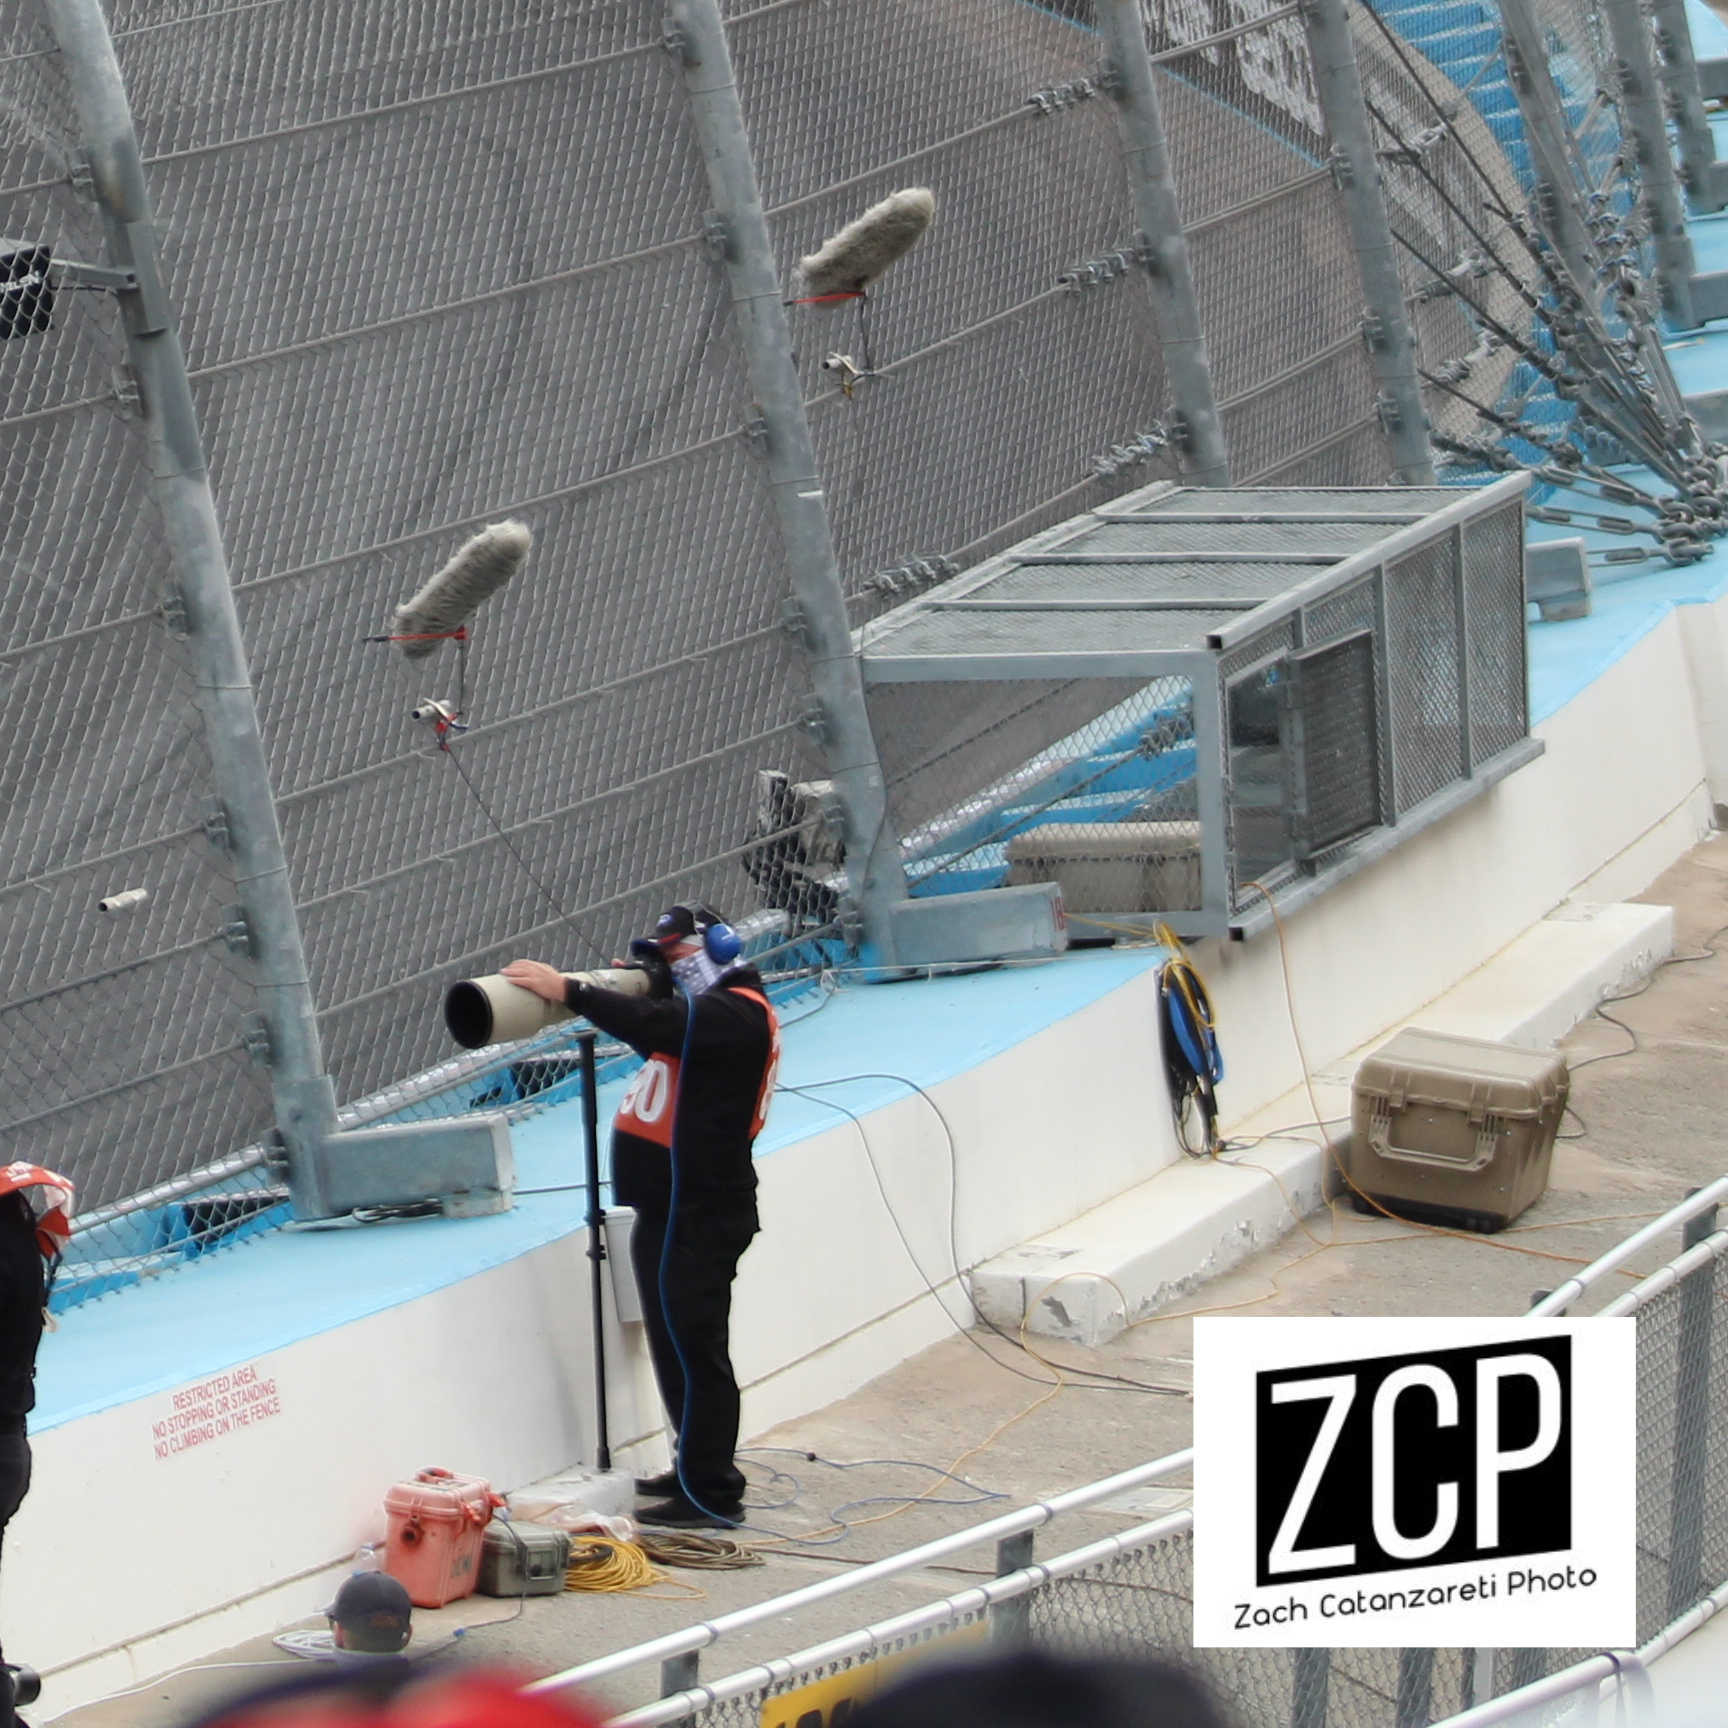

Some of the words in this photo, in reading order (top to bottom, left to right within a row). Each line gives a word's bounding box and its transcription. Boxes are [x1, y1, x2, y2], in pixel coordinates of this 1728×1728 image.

[151, 1421, 167, 1440] NO
[167, 1402, 215, 1434] STOPPING
[215, 1395, 231, 1416] OR
[231, 1378, 277, 1410] STANDING
[172, 1375, 230, 1411] RESTRICTED
[231, 1366, 258, 1388] AREA
[153, 1440, 169, 1460] NO
[169, 1422, 215, 1454] CLIMBING
[215, 1416, 231, 1436] ON
[230, 1408, 251, 1430] THE
[250, 1396, 281, 1422] FENCE
